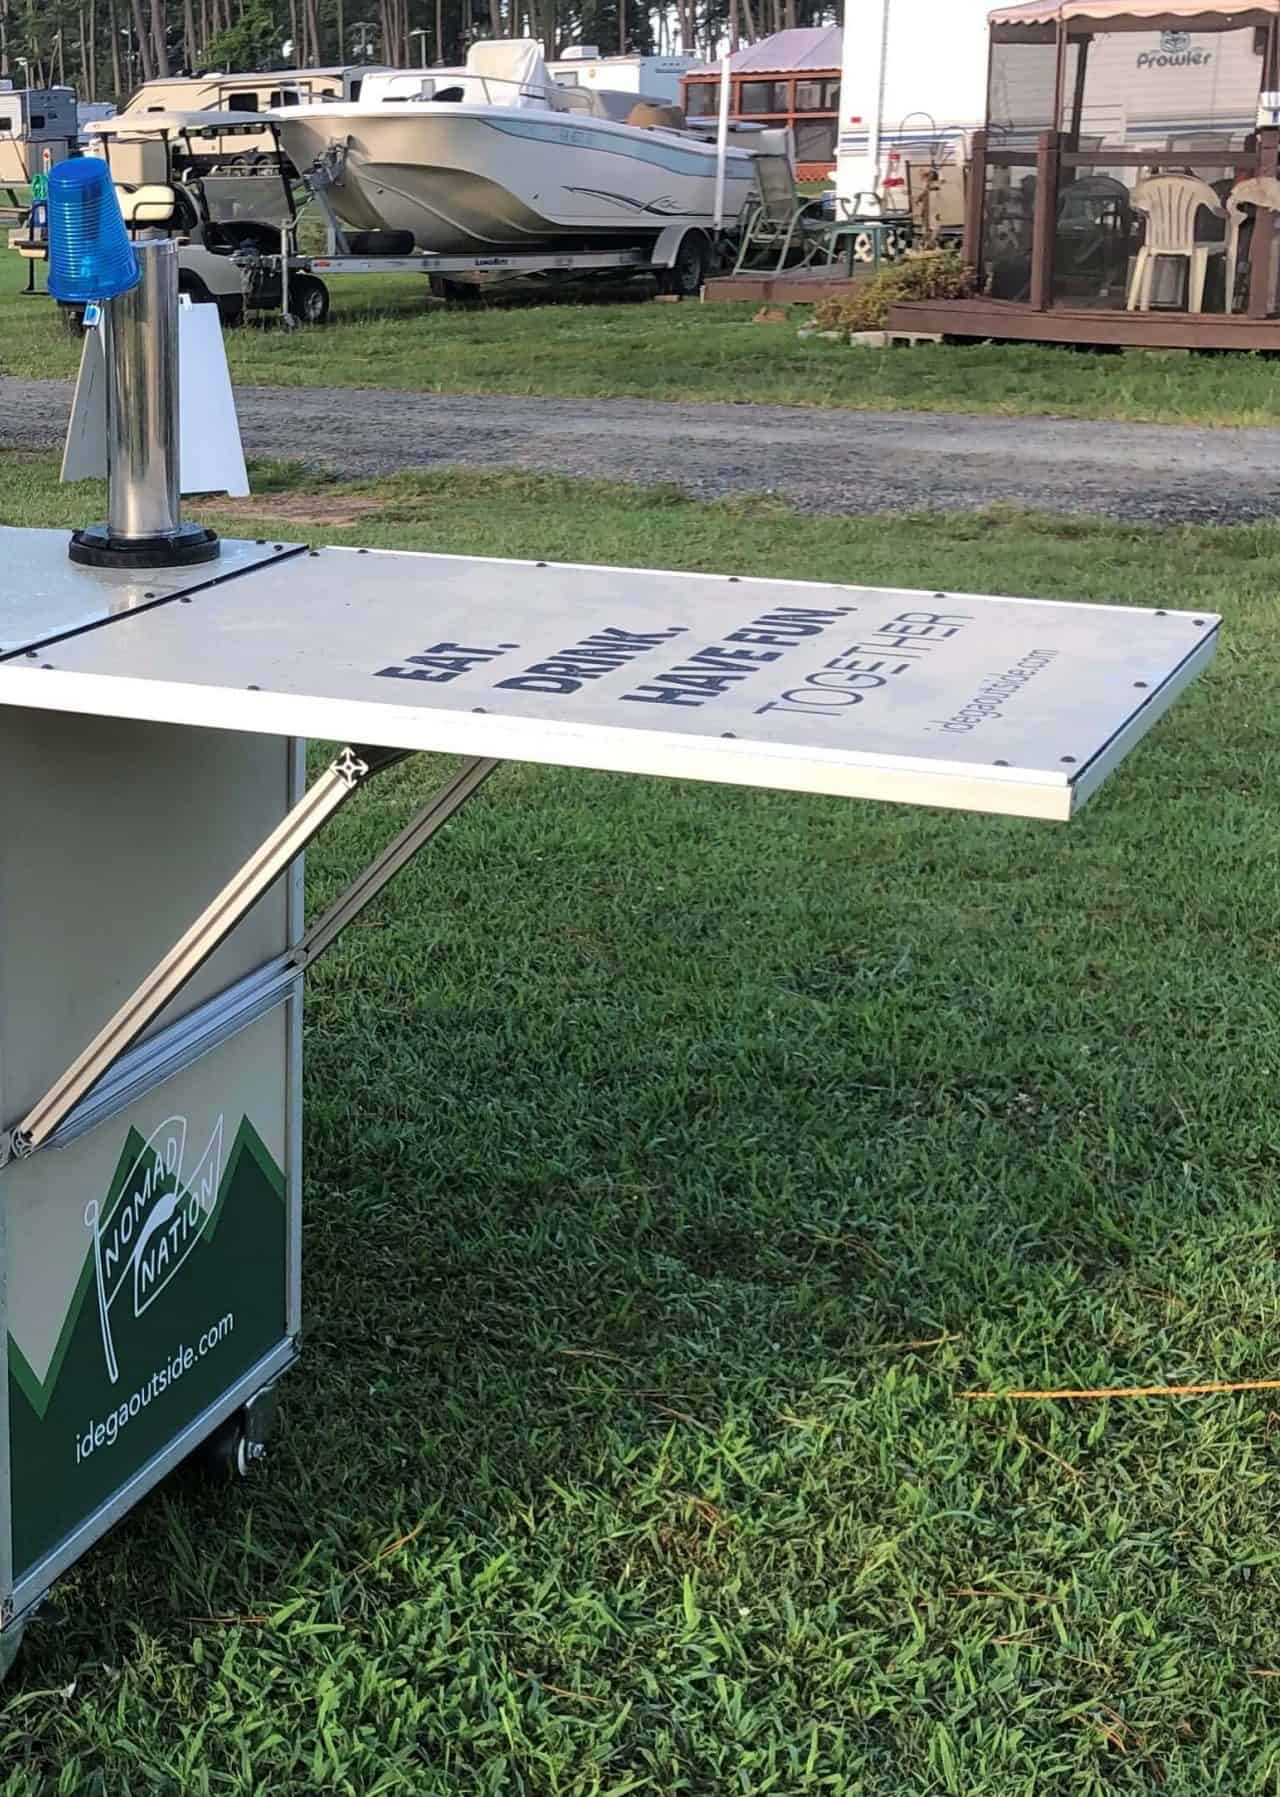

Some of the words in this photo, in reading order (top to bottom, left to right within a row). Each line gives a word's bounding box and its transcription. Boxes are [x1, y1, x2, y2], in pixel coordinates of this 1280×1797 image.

[1136, 52, 1213, 69] Prowler
[372, 643, 520, 683] EAT.
[492, 626, 689, 694] DRINK.
[618, 646, 784, 706] HAVE
[723, 606, 858, 647] FUN.
[752, 611, 974, 716] TOGETHER
[924, 647, 1060, 734] idegaoutside.com
[106, 1137, 177, 1279] NOMAD
[141, 1161, 214, 1293] NATION
[75, 1312, 234, 1464] idegaoutside.com
